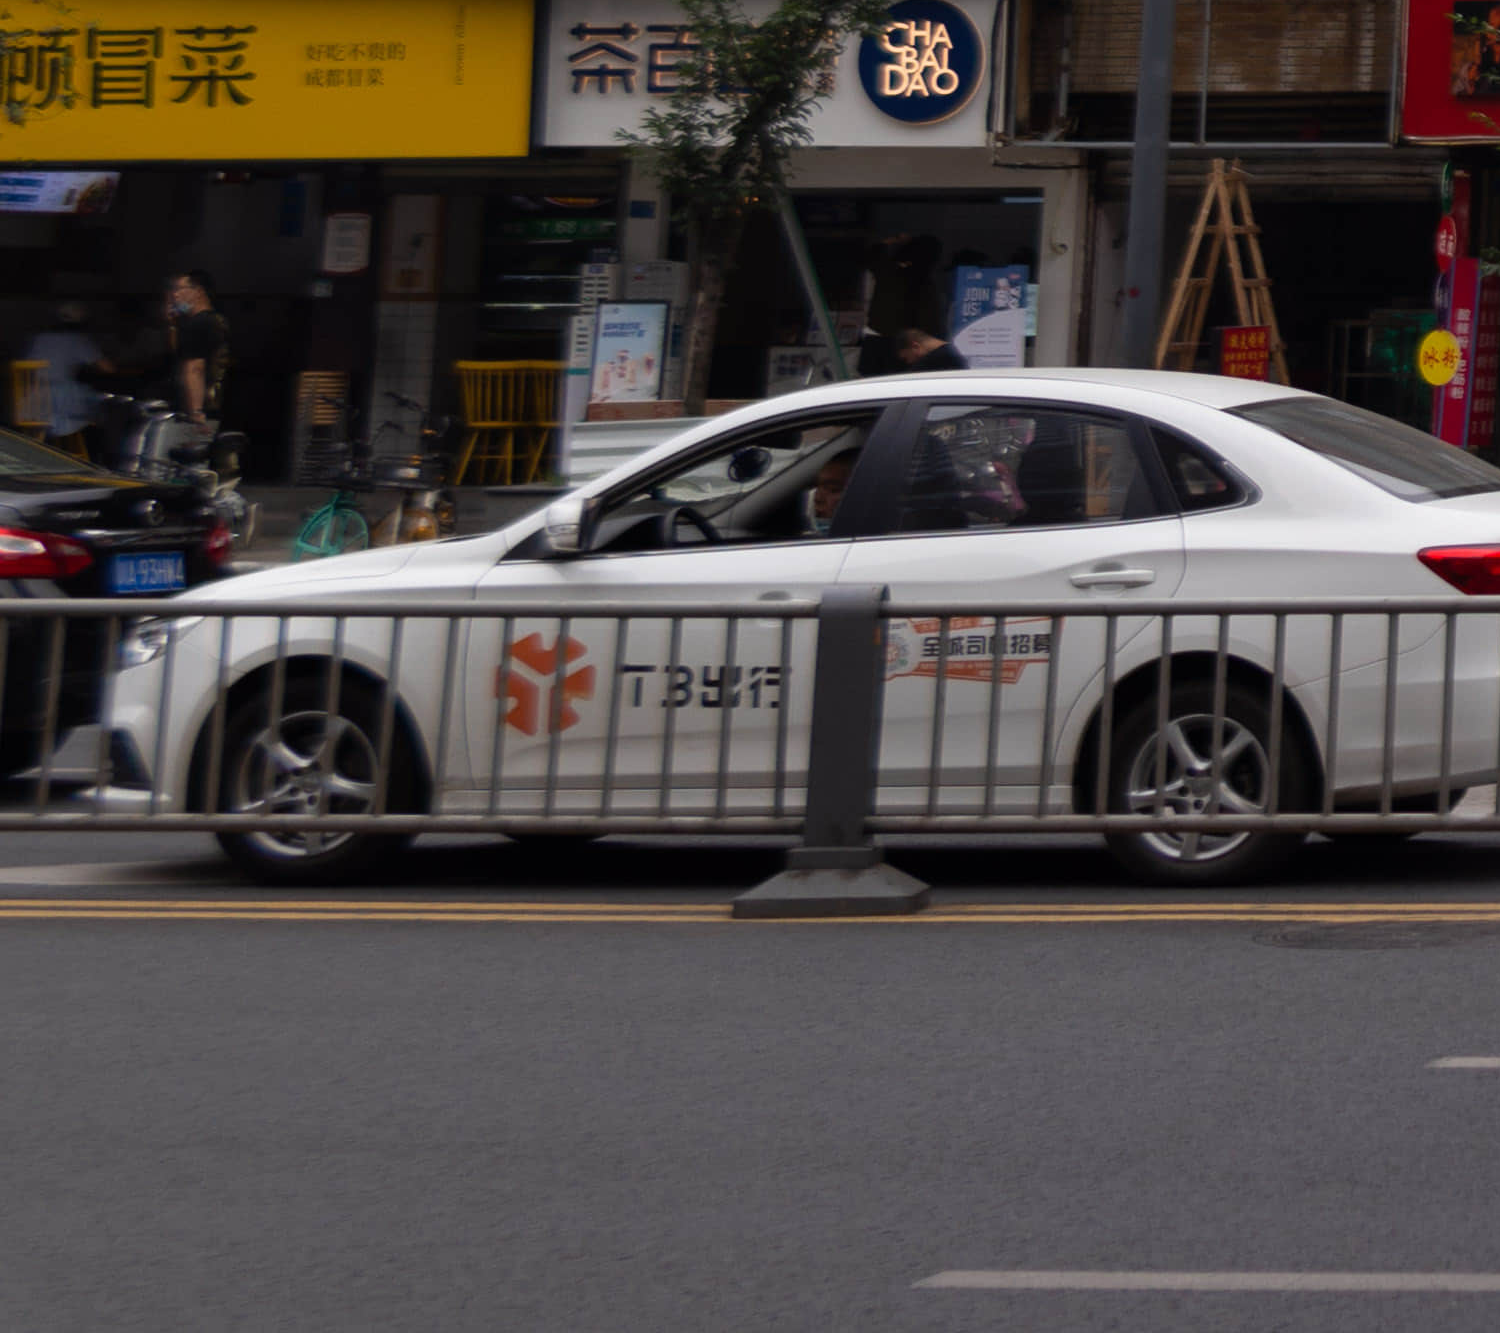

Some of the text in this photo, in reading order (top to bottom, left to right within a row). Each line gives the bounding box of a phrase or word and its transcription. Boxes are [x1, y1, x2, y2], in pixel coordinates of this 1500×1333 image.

[882, 19, 953, 54] CHA
[568, 21, 757, 96] 茶百
[900, 48, 951, 74] BAI
[877, 64, 960, 98] DAO
[963, 287, 990, 304] JOIN
